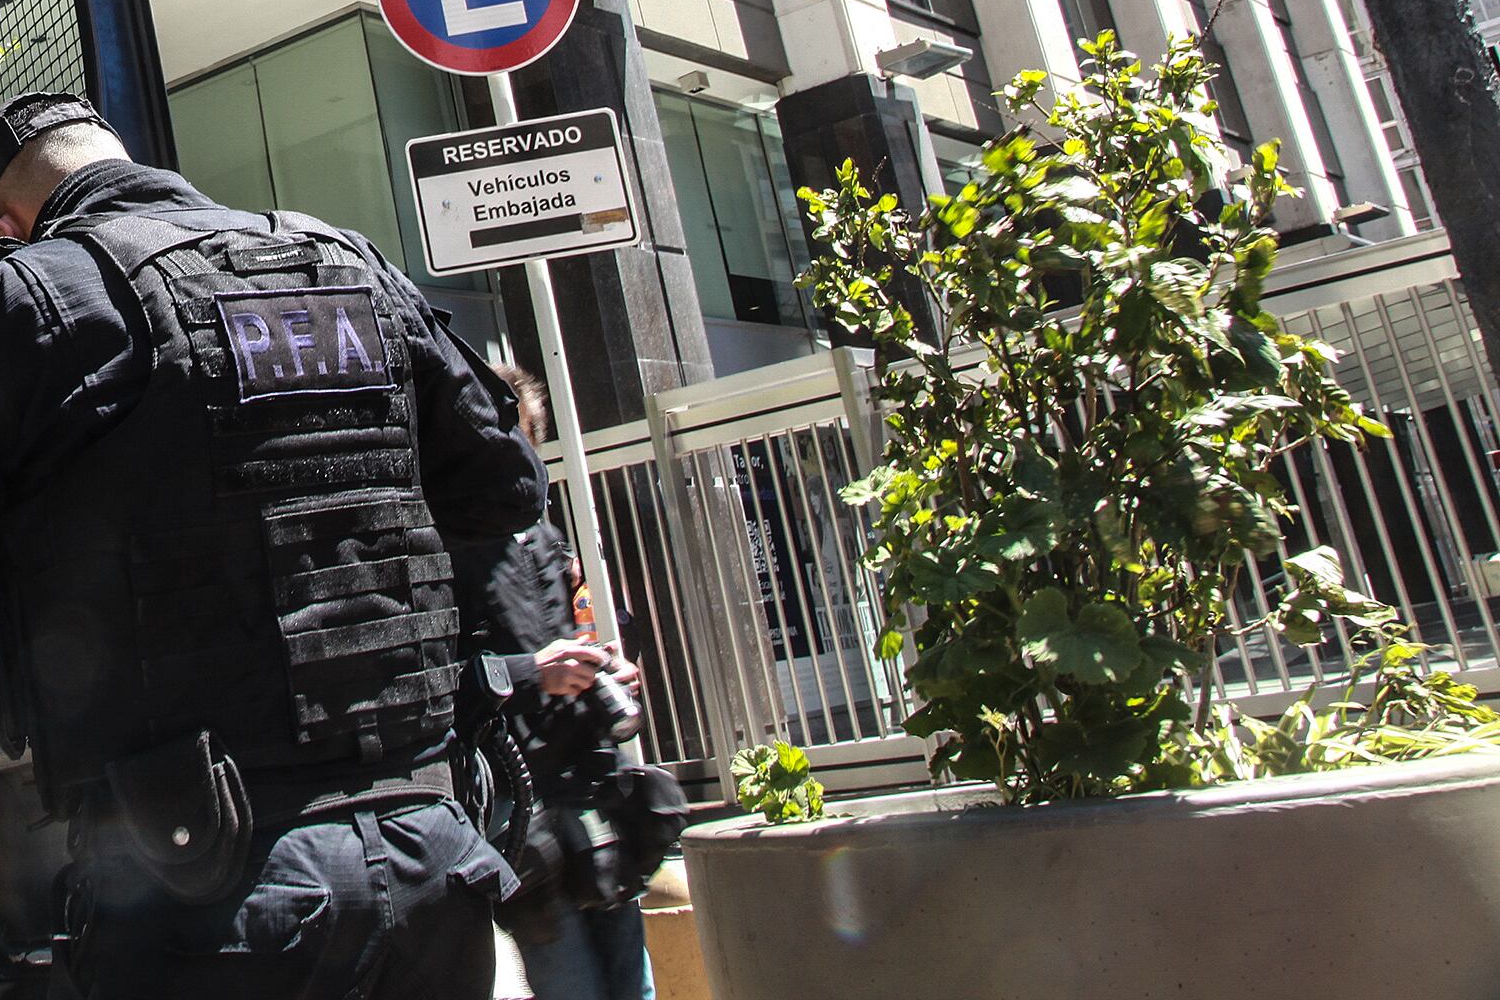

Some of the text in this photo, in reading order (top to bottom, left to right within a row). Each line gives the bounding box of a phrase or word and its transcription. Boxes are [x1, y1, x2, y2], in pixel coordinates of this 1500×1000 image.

[442, 126, 582, 165] RESERVADO
[467, 169, 571, 197] Vehículos
[473, 192, 577, 222] Embajada
[232, 307, 385, 380] P.F.A.
